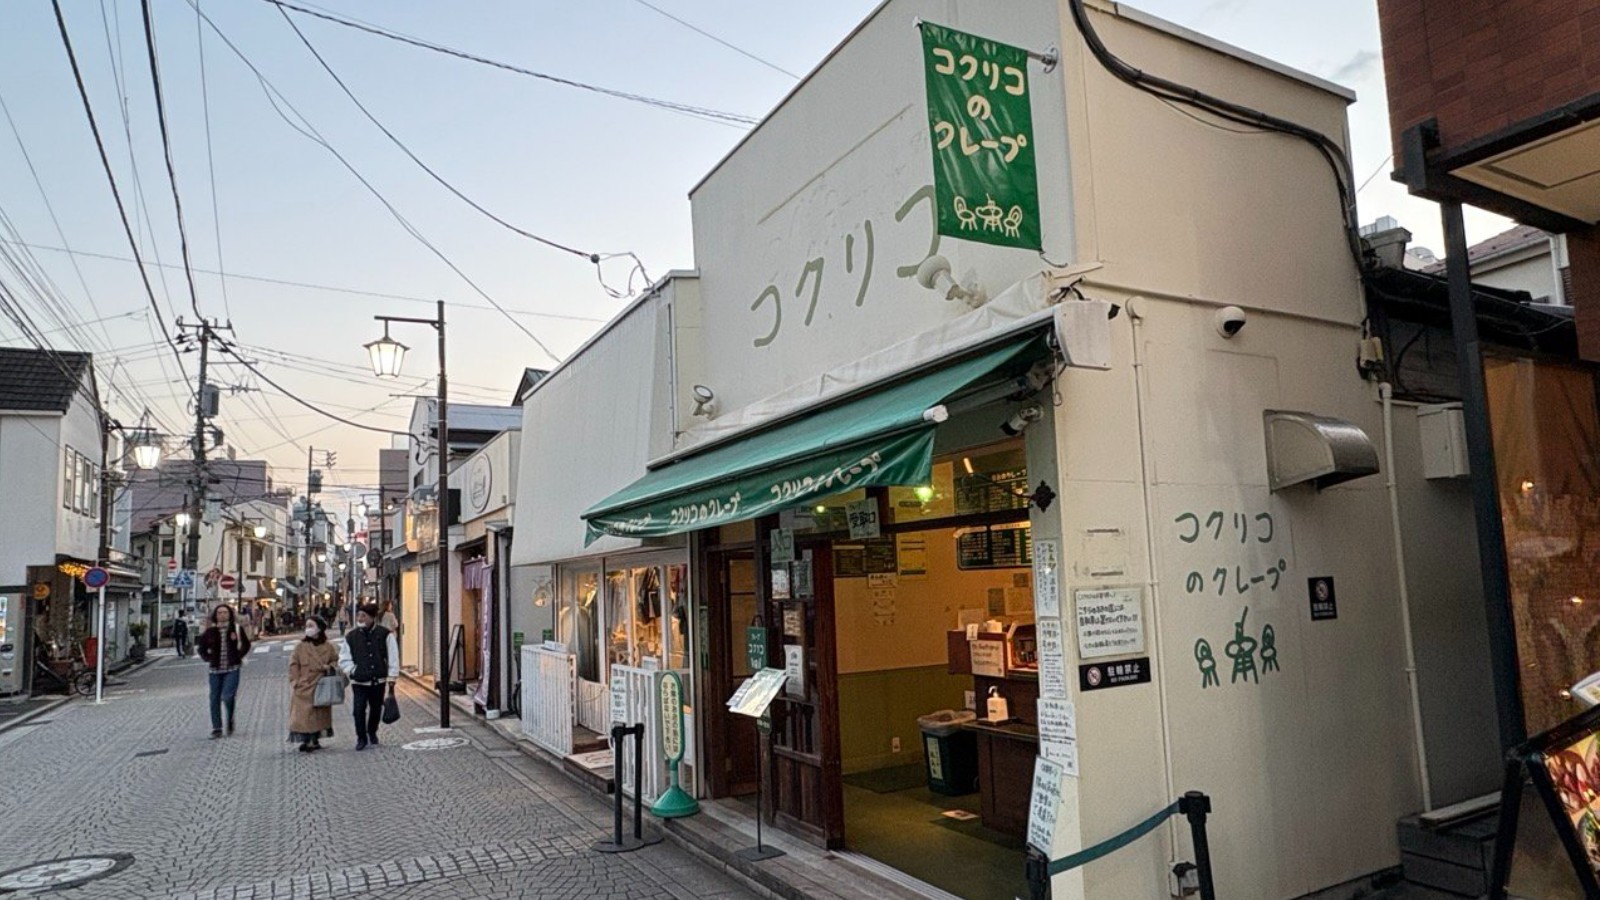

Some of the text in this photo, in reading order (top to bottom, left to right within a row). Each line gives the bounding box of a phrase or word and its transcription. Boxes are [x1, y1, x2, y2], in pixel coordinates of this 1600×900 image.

[932, 47, 1025, 96] コクリコ
[967, 94, 991, 121] の
[934, 121, 1027, 163] クレープ
[750, 184, 940, 348] コクリコ
[670, 491, 742, 525] コクリコのクレープ
[1174, 510, 1274, 544] コクリコ
[1186, 558, 1287, 596] のクレープ
